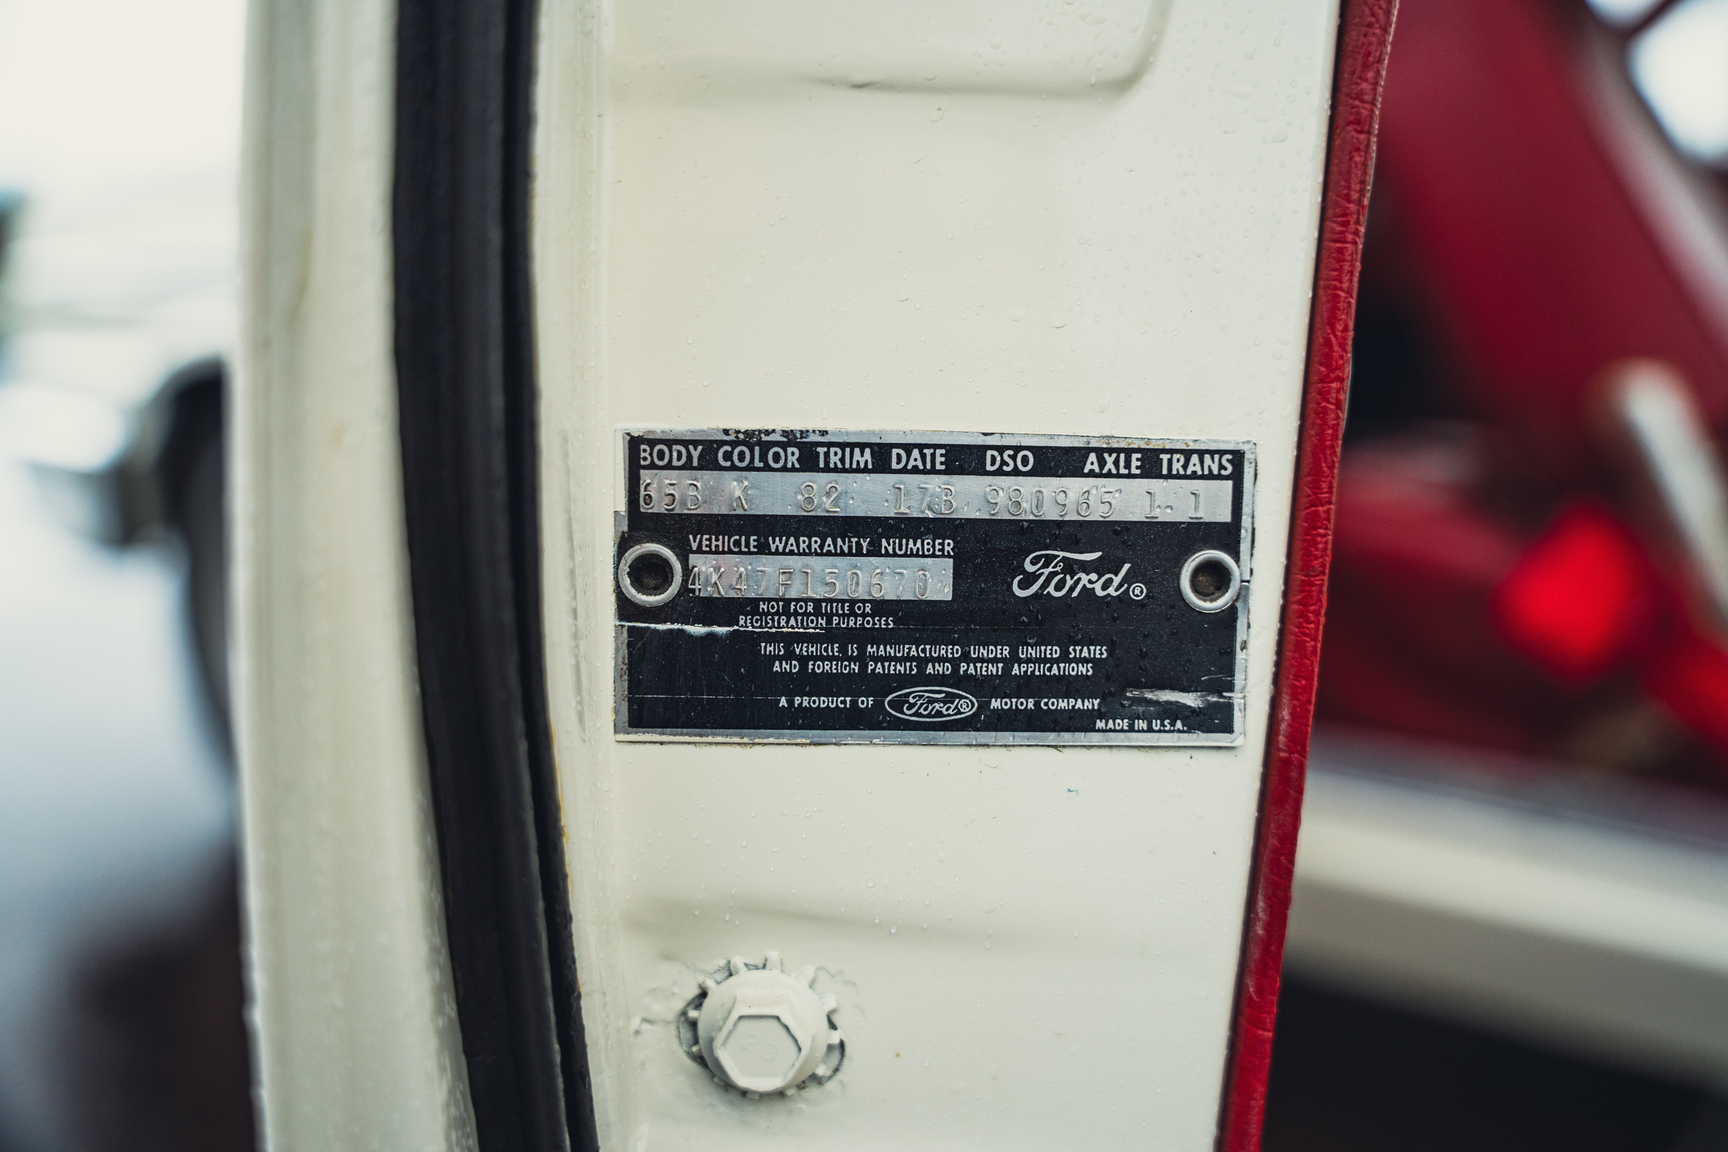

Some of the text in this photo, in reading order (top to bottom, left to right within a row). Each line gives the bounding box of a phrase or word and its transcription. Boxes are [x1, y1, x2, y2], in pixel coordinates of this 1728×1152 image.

[640, 444, 1233, 475] BODY COLOR TRIM DATE DSO AXLE TRANS
[730, 481, 749, 512] K
[800, 482, 841, 513] 82
[689, 534, 954, 556] VEHICLE WARRANTY NUMBER
[759, 602, 872, 614] NOT FOR TITLE OR
[739, 615, 894, 629] REGISTRATION PURPOSES
[760, 643, 785, 655] THIS
[848, 644, 858, 656] IS
[867, 644, 962, 657] MANUFACTURED
[970, 646, 1010, 659] UNDER
[1019, 646, 1061, 658] UNITED
[1069, 646, 1108, 659] STATES
[773, 660, 1094, 676] AND FOREIGN PATENTS AND PATENT APPLICATIONS
[779, 697, 788, 708] A
[794, 697, 851, 708] PRODUCT
[858, 697, 874, 708] OF
[990, 699, 1034, 710] MOTOR
[1040, 699, 1100, 710] COMPANY
[1096, 719, 1188, 731] MADE IN U.S.A.
